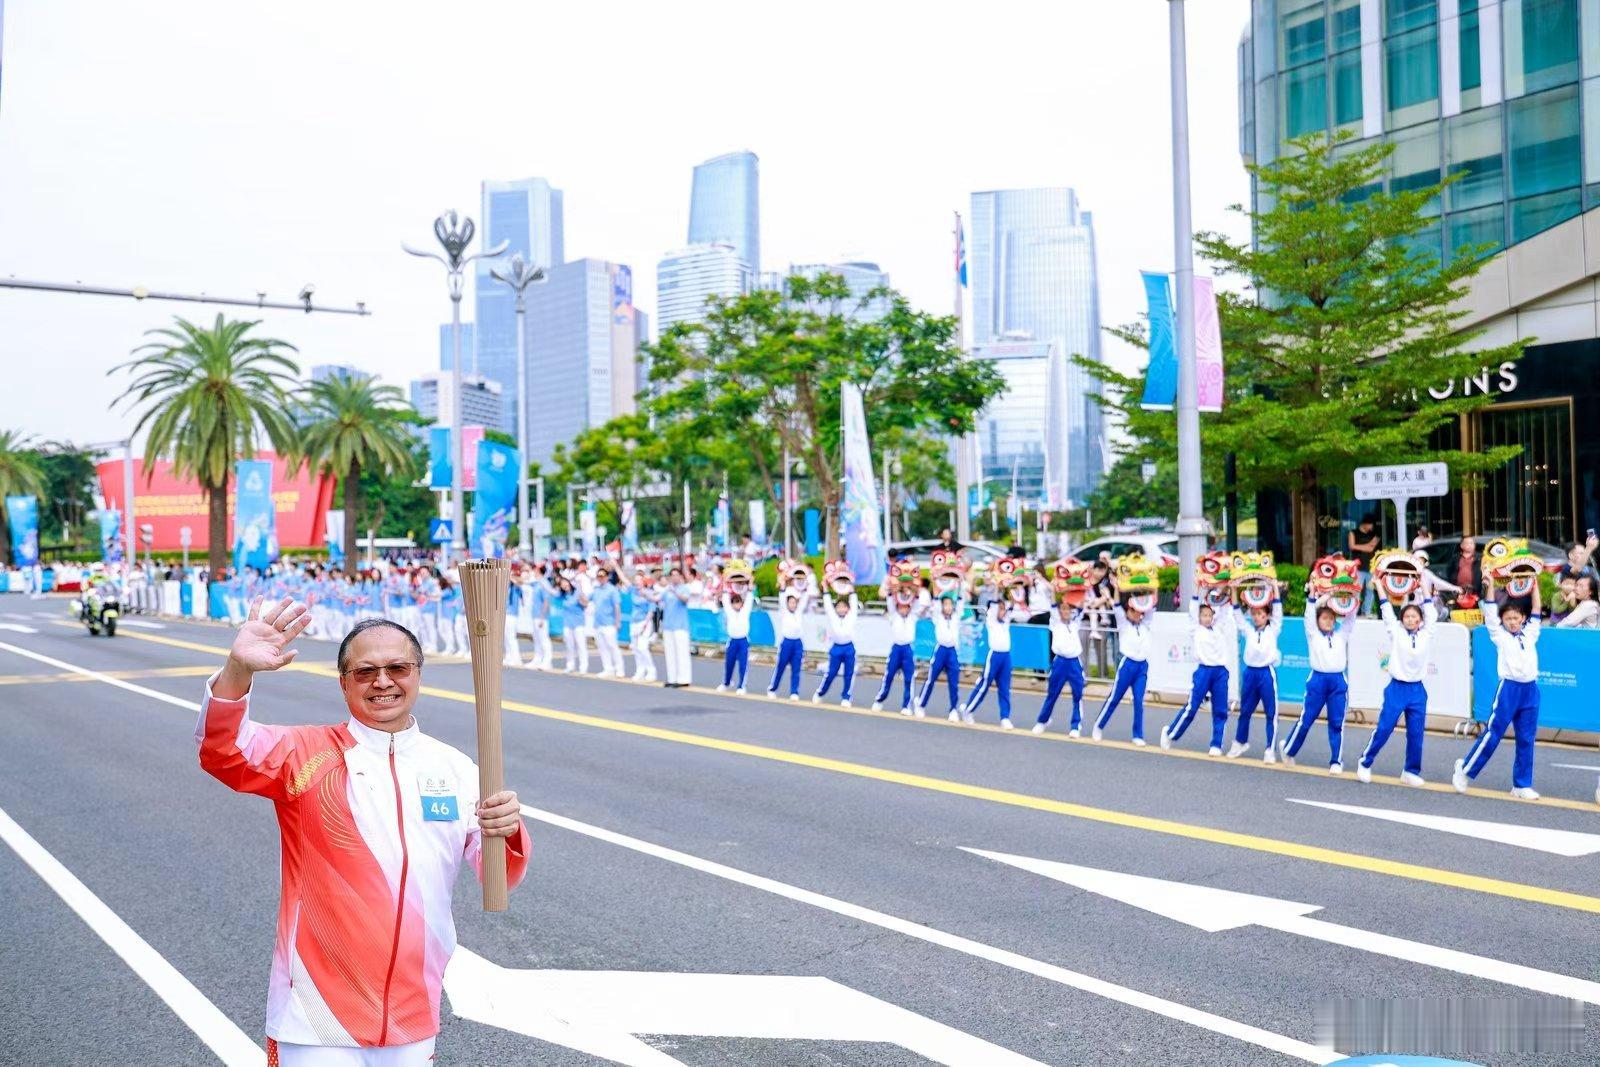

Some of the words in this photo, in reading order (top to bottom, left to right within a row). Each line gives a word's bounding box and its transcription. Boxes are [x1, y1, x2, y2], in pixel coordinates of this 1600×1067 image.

[1374, 469, 1425, 483] 前海大道
[430, 802, 450, 815] 46
